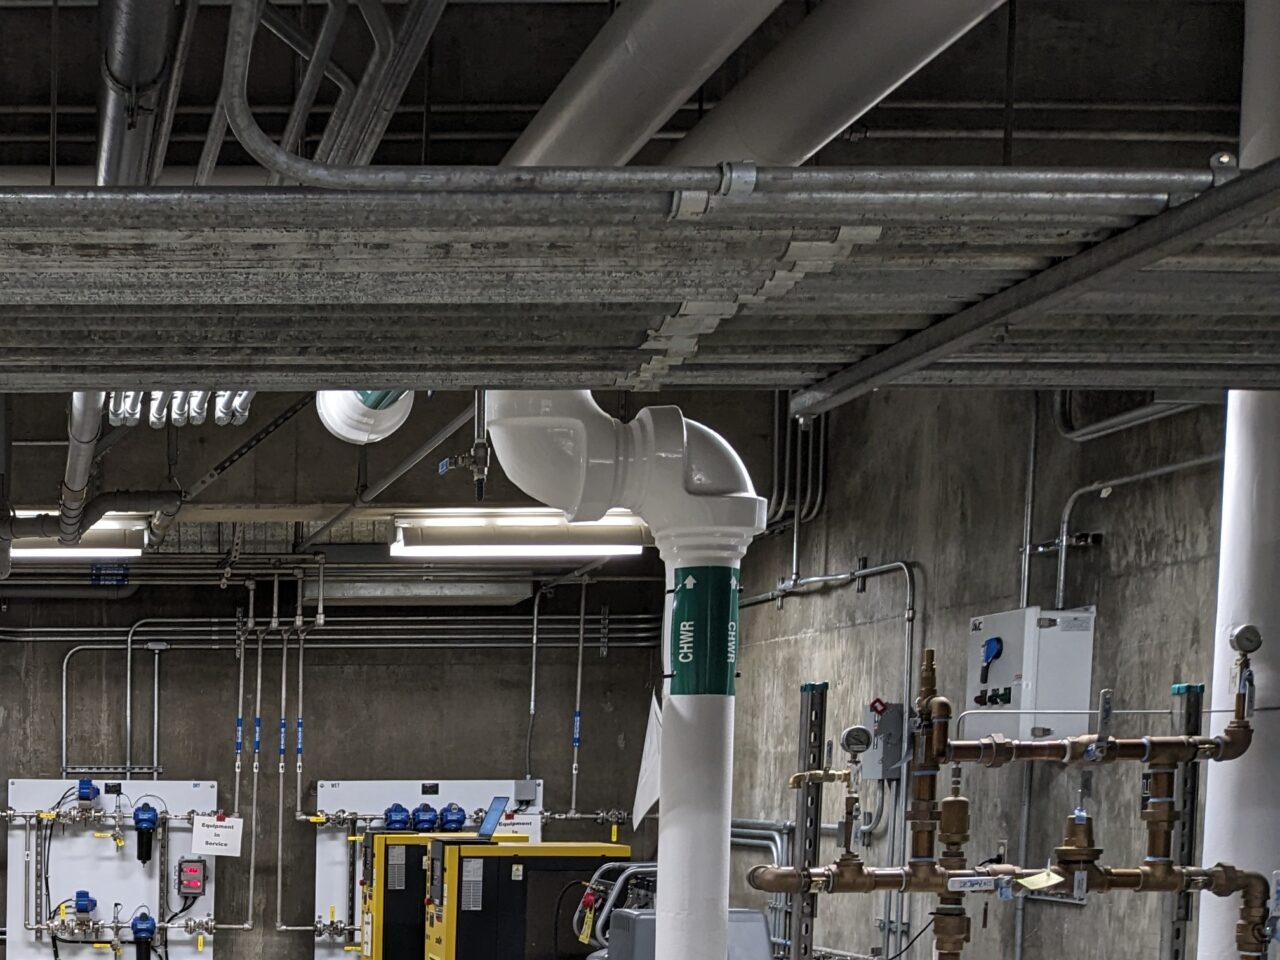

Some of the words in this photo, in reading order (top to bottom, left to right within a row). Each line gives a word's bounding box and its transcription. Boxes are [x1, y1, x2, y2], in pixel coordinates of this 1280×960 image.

[678, 621, 694, 663] CHWR
[727, 621, 736, 663] CHWR
[201, 822, 234, 830] Equipment
